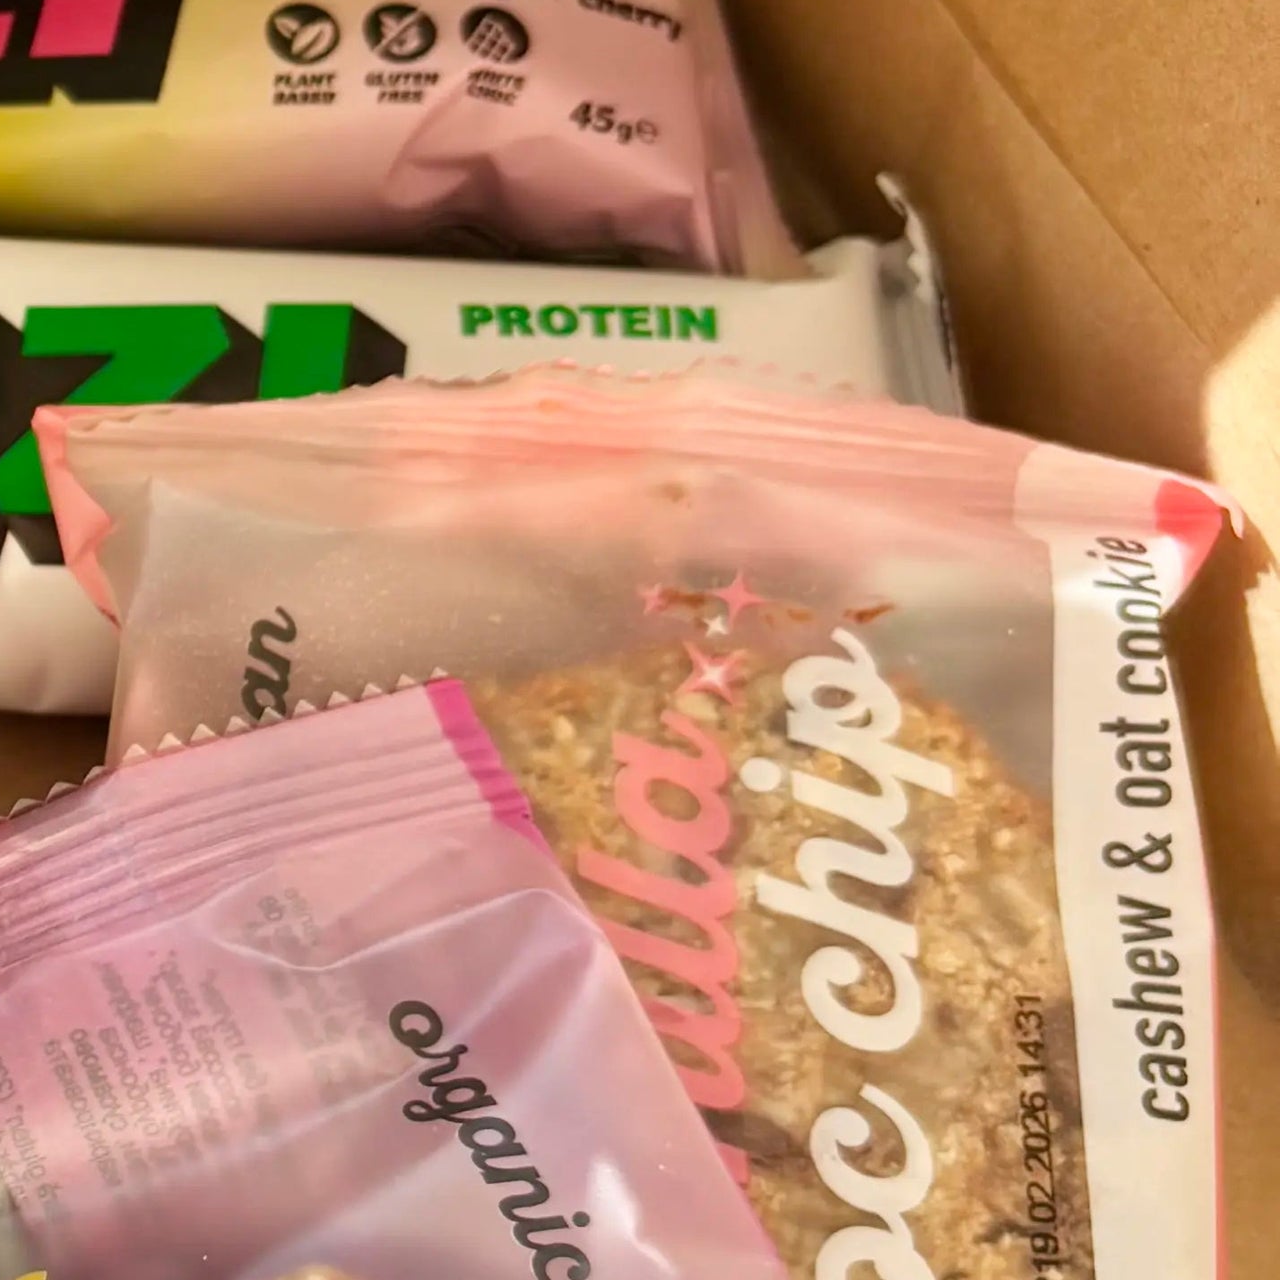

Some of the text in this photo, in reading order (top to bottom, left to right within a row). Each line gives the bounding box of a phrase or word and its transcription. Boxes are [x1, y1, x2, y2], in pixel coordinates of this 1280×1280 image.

[458, 300, 720, 344] PROTEIN
[740, 628, 956, 1052] chip
[1085, 534, 1192, 1124] cashew & oat cookie
